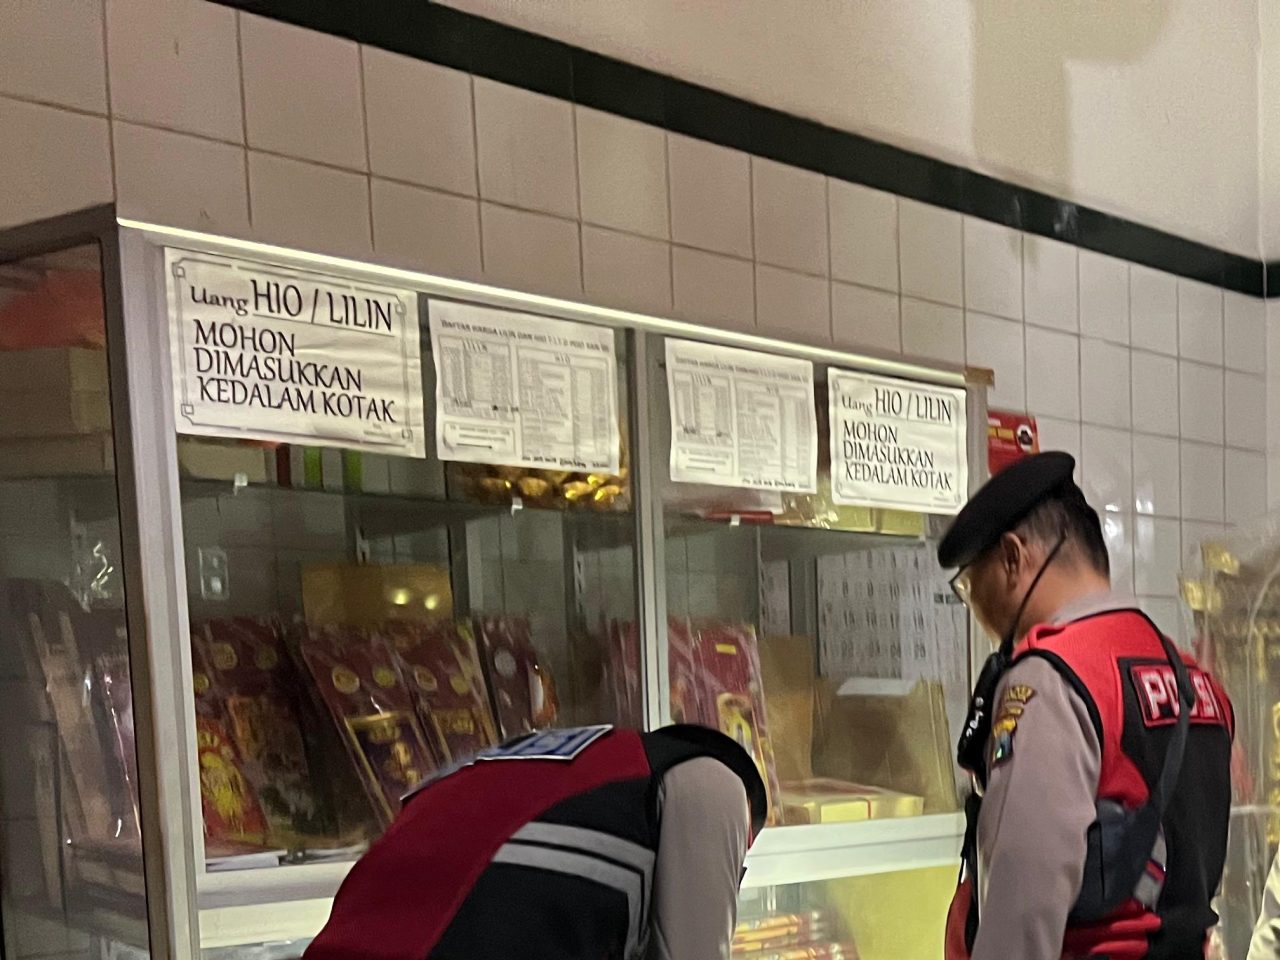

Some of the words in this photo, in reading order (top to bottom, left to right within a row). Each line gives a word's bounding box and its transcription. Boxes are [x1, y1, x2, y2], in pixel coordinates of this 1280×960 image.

[191, 286, 248, 315] Uang
[251, 280, 303, 317] HIO
[326, 292, 393, 332] LILIN
[194, 319, 295, 356] MOHON
[194, 348, 362, 392] DIMASUKKAN
[197, 376, 317, 413] KEDALAM
[321, 392, 396, 423] KOTAK
[841, 395, 873, 417] Uang
[874, 388, 902, 416] HIO
[916, 394, 952, 423] LILIN
[843, 420, 898, 444] MOHON
[843, 440, 934, 468] DIMASUKKAN
[845, 461, 908, 487] KEDALAM
[911, 470, 952, 491] KOTAK
